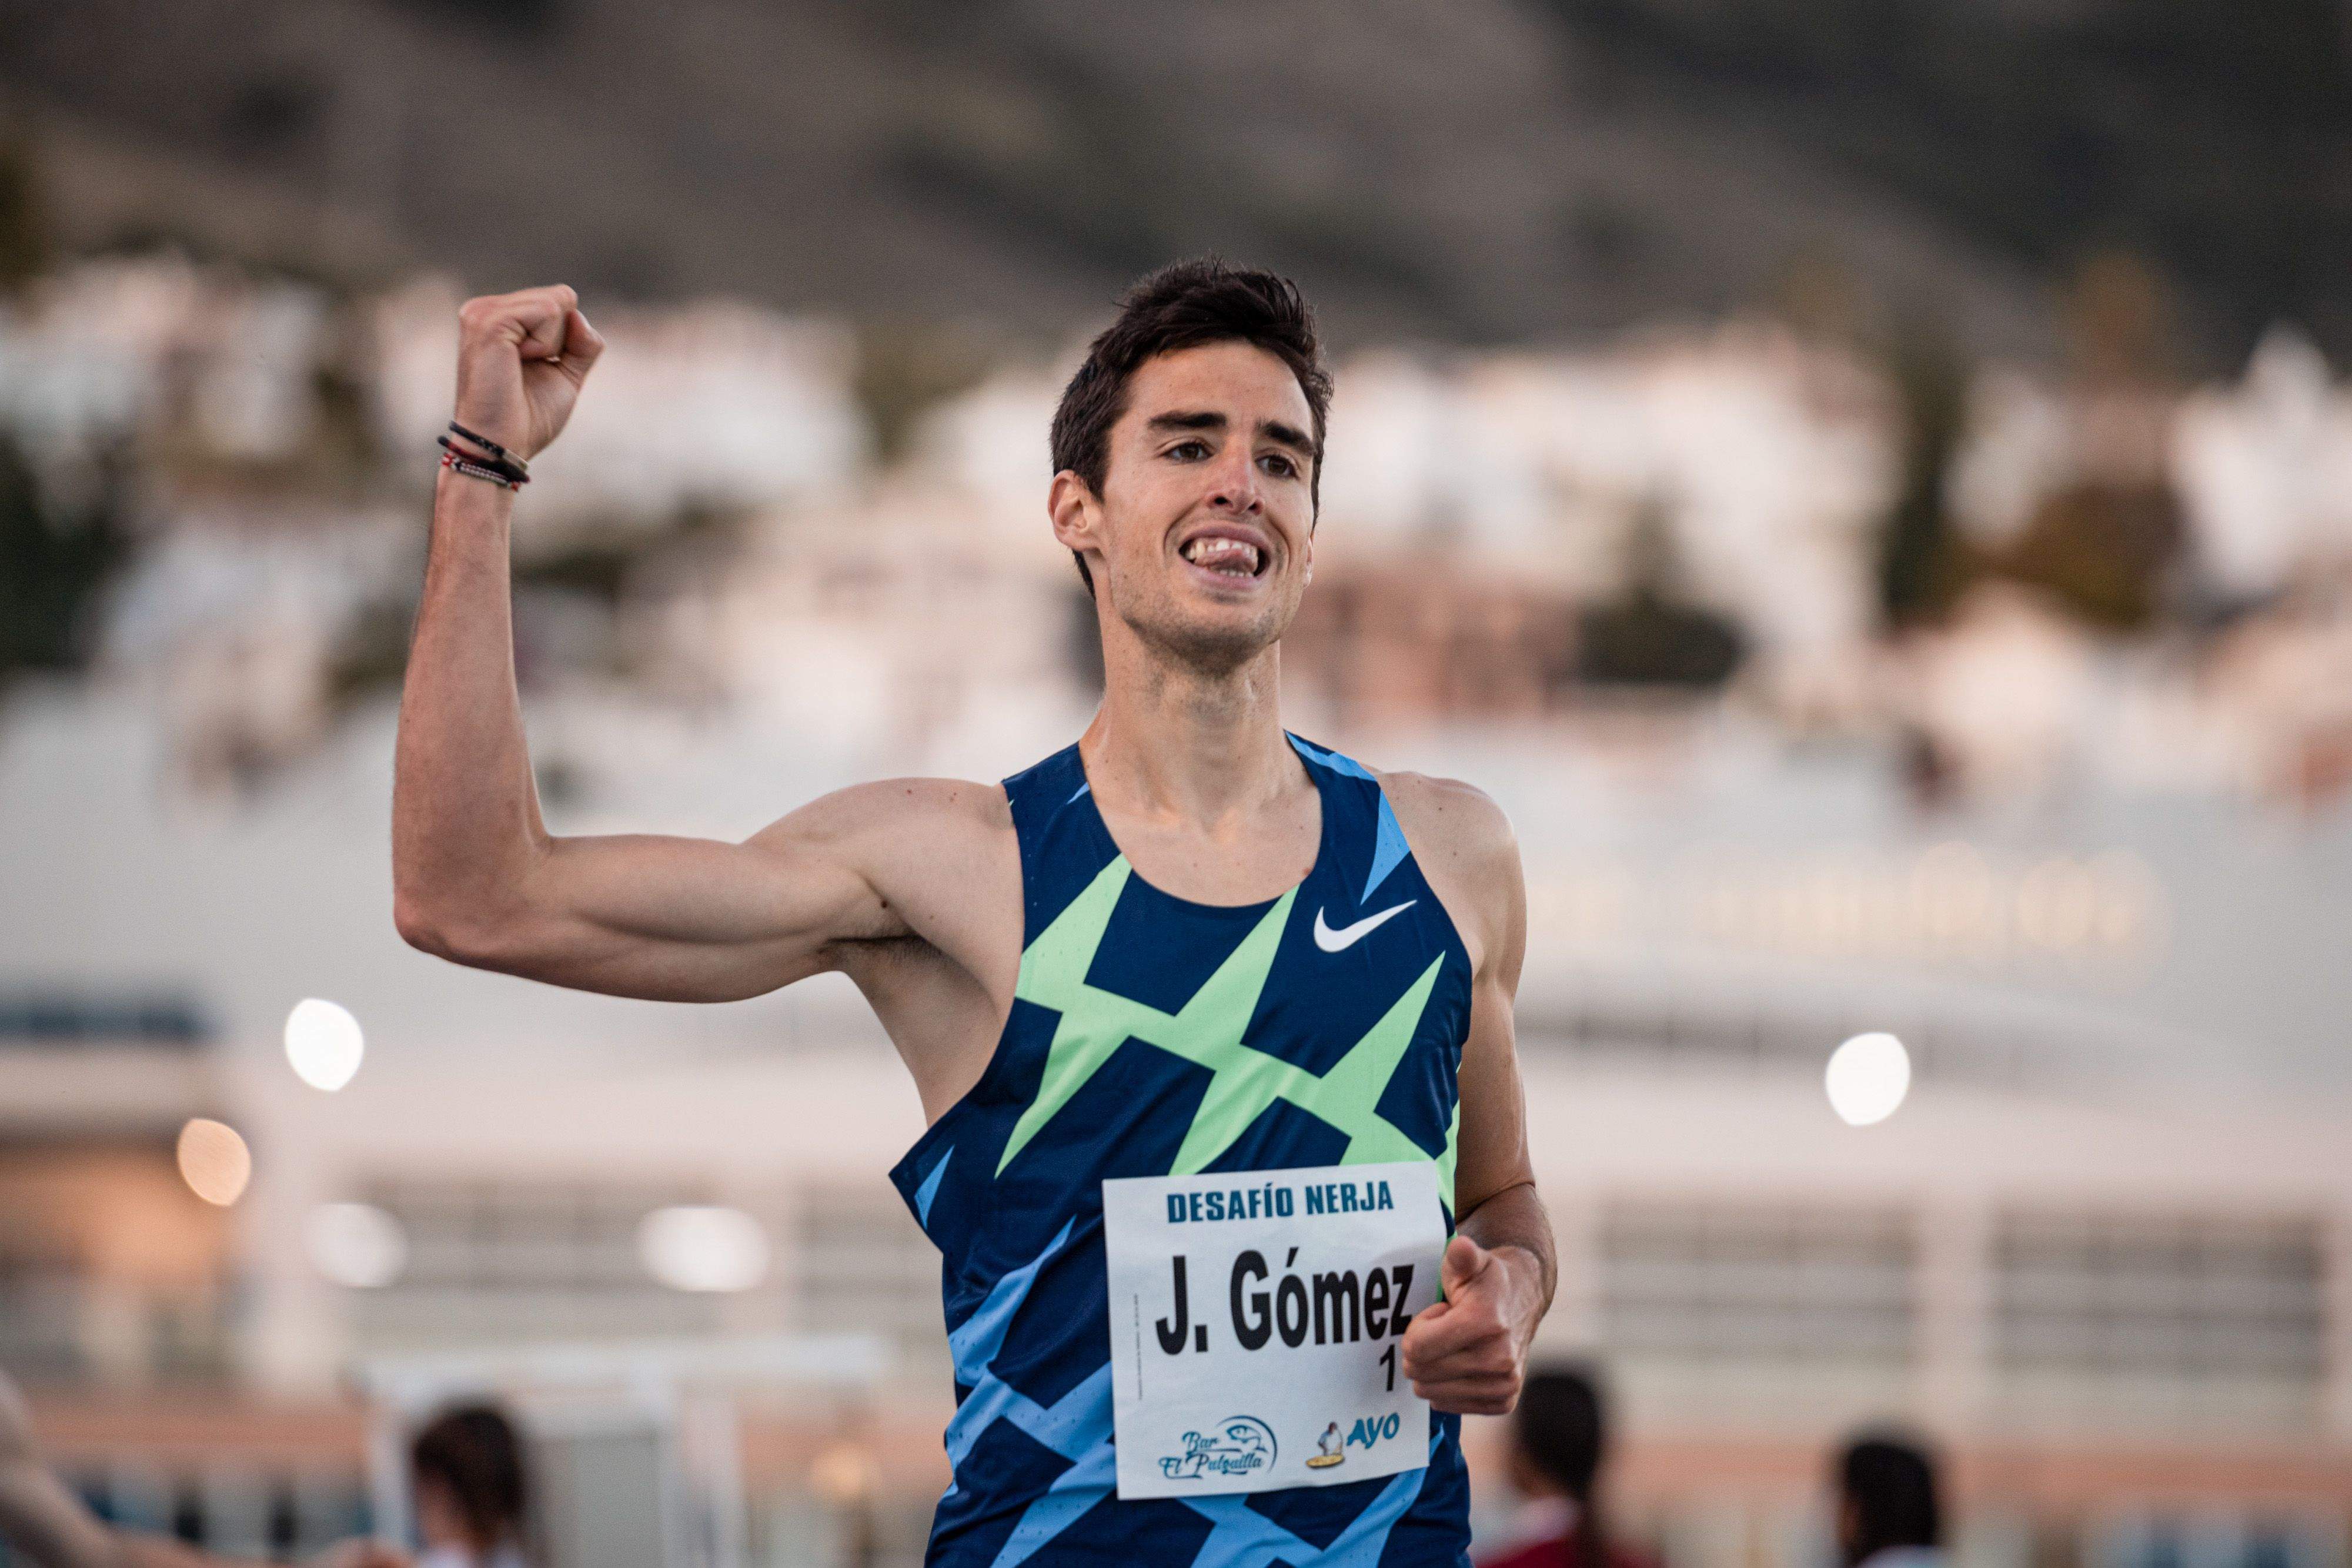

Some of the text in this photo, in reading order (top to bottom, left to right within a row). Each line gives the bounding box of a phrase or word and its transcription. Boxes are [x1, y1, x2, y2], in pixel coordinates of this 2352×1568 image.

[1167, 1181, 1394, 1223] DESAFÍO NERJA
[1155, 1255, 1208, 1355] J.
[1230, 1246, 1415, 1351] Gómez
[1379, 1343, 1395, 1392] 1
[1182, 1431, 1219, 1456] Bar
[1347, 1412, 1400, 1450] AYO
